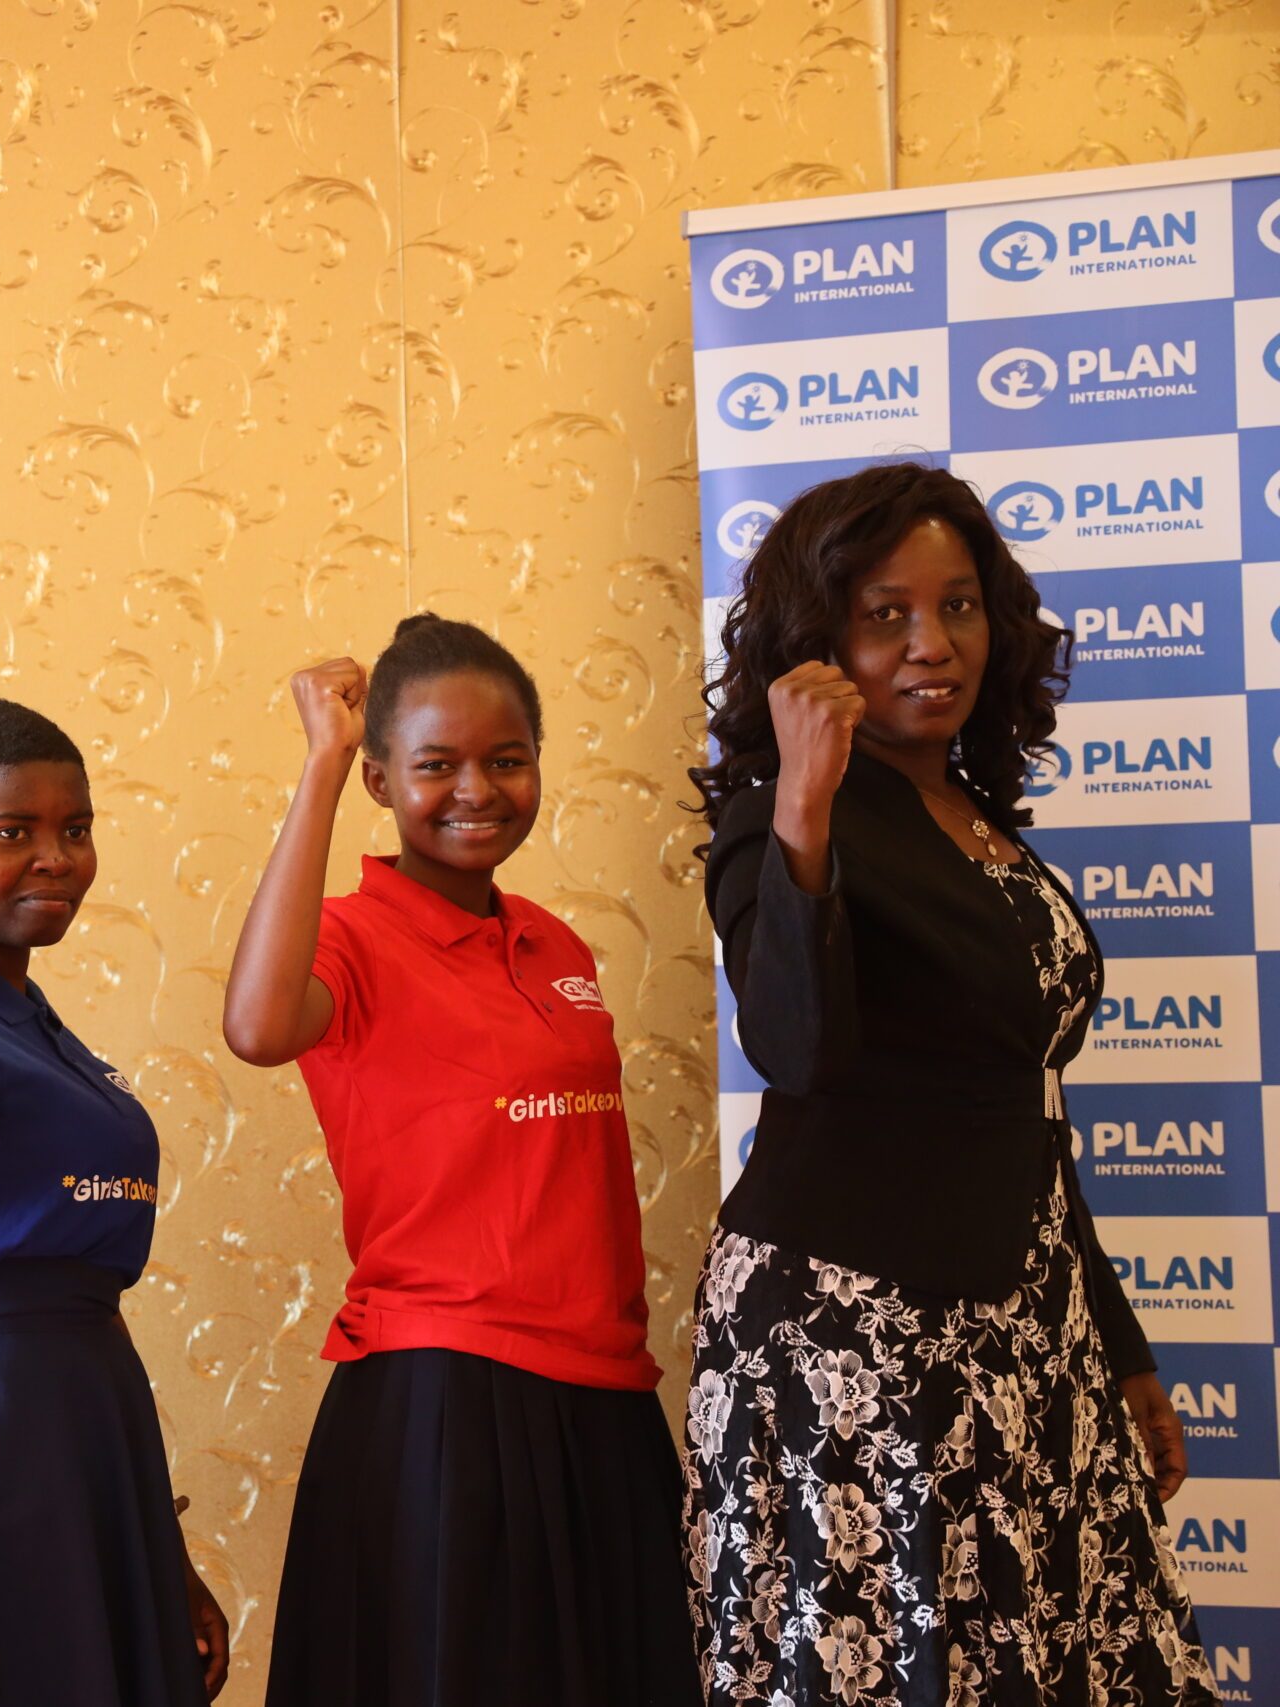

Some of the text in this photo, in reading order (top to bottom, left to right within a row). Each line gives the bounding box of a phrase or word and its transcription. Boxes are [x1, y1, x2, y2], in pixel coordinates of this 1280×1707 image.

[1068, 210, 1197, 257] PLAN
[793, 240, 914, 285] PLAN
[1070, 254, 1197, 276] INTERNATIONAL
[794, 281, 914, 303] INTERNATIONAL
[1068, 340, 1197, 385] PLAN
[799, 365, 919, 407] PLAN
[1069, 383, 1197, 404] INTERNATIONAL
[800, 406, 919, 426] INTERNATIONAL
[1075, 476, 1204, 518] PLAN
[1077, 519, 1204, 537] INTERNATIONAL
[1075, 602, 1205, 643] PLAN
[1077, 644, 1205, 662] INTERNATIONAL
[1083, 736, 1212, 775] PLAN
[1085, 779, 1213, 794] INTERNATIONAL
[1083, 862, 1214, 900] PLAN
[1085, 905, 1214, 919] INTERNATIONAL
[1092, 995, 1222, 1030] PLAN
[1094, 1037, 1223, 1050] INTERNATIONAL
[1092, 1121, 1225, 1157] PLAN
[1095, 1164, 1225, 1175] INTERNATIONAL
[1129, 1299, 1235, 1309] ERNATIONAL
[1170, 1383, 1238, 1418] AN
[1175, 1518, 1247, 1553] AN
[1179, 1561, 1248, 1573] ATIONAL
